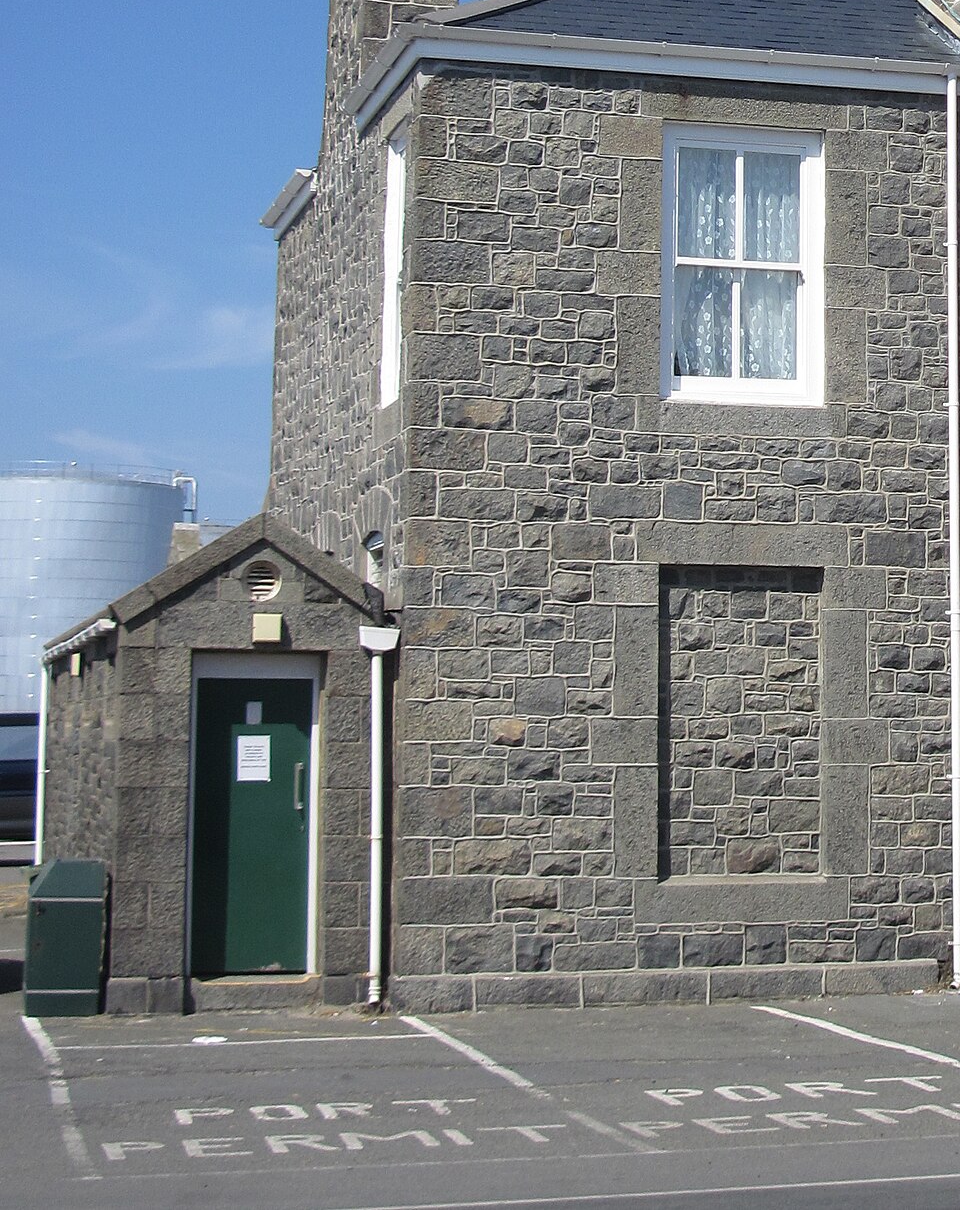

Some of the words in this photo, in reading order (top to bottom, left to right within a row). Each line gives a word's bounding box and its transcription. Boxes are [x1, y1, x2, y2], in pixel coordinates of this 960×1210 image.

[645, 1074, 943, 1107] PORT
[173, 1097, 477, 1126] PORT
[100, 1123, 567, 1161] PERMIT
